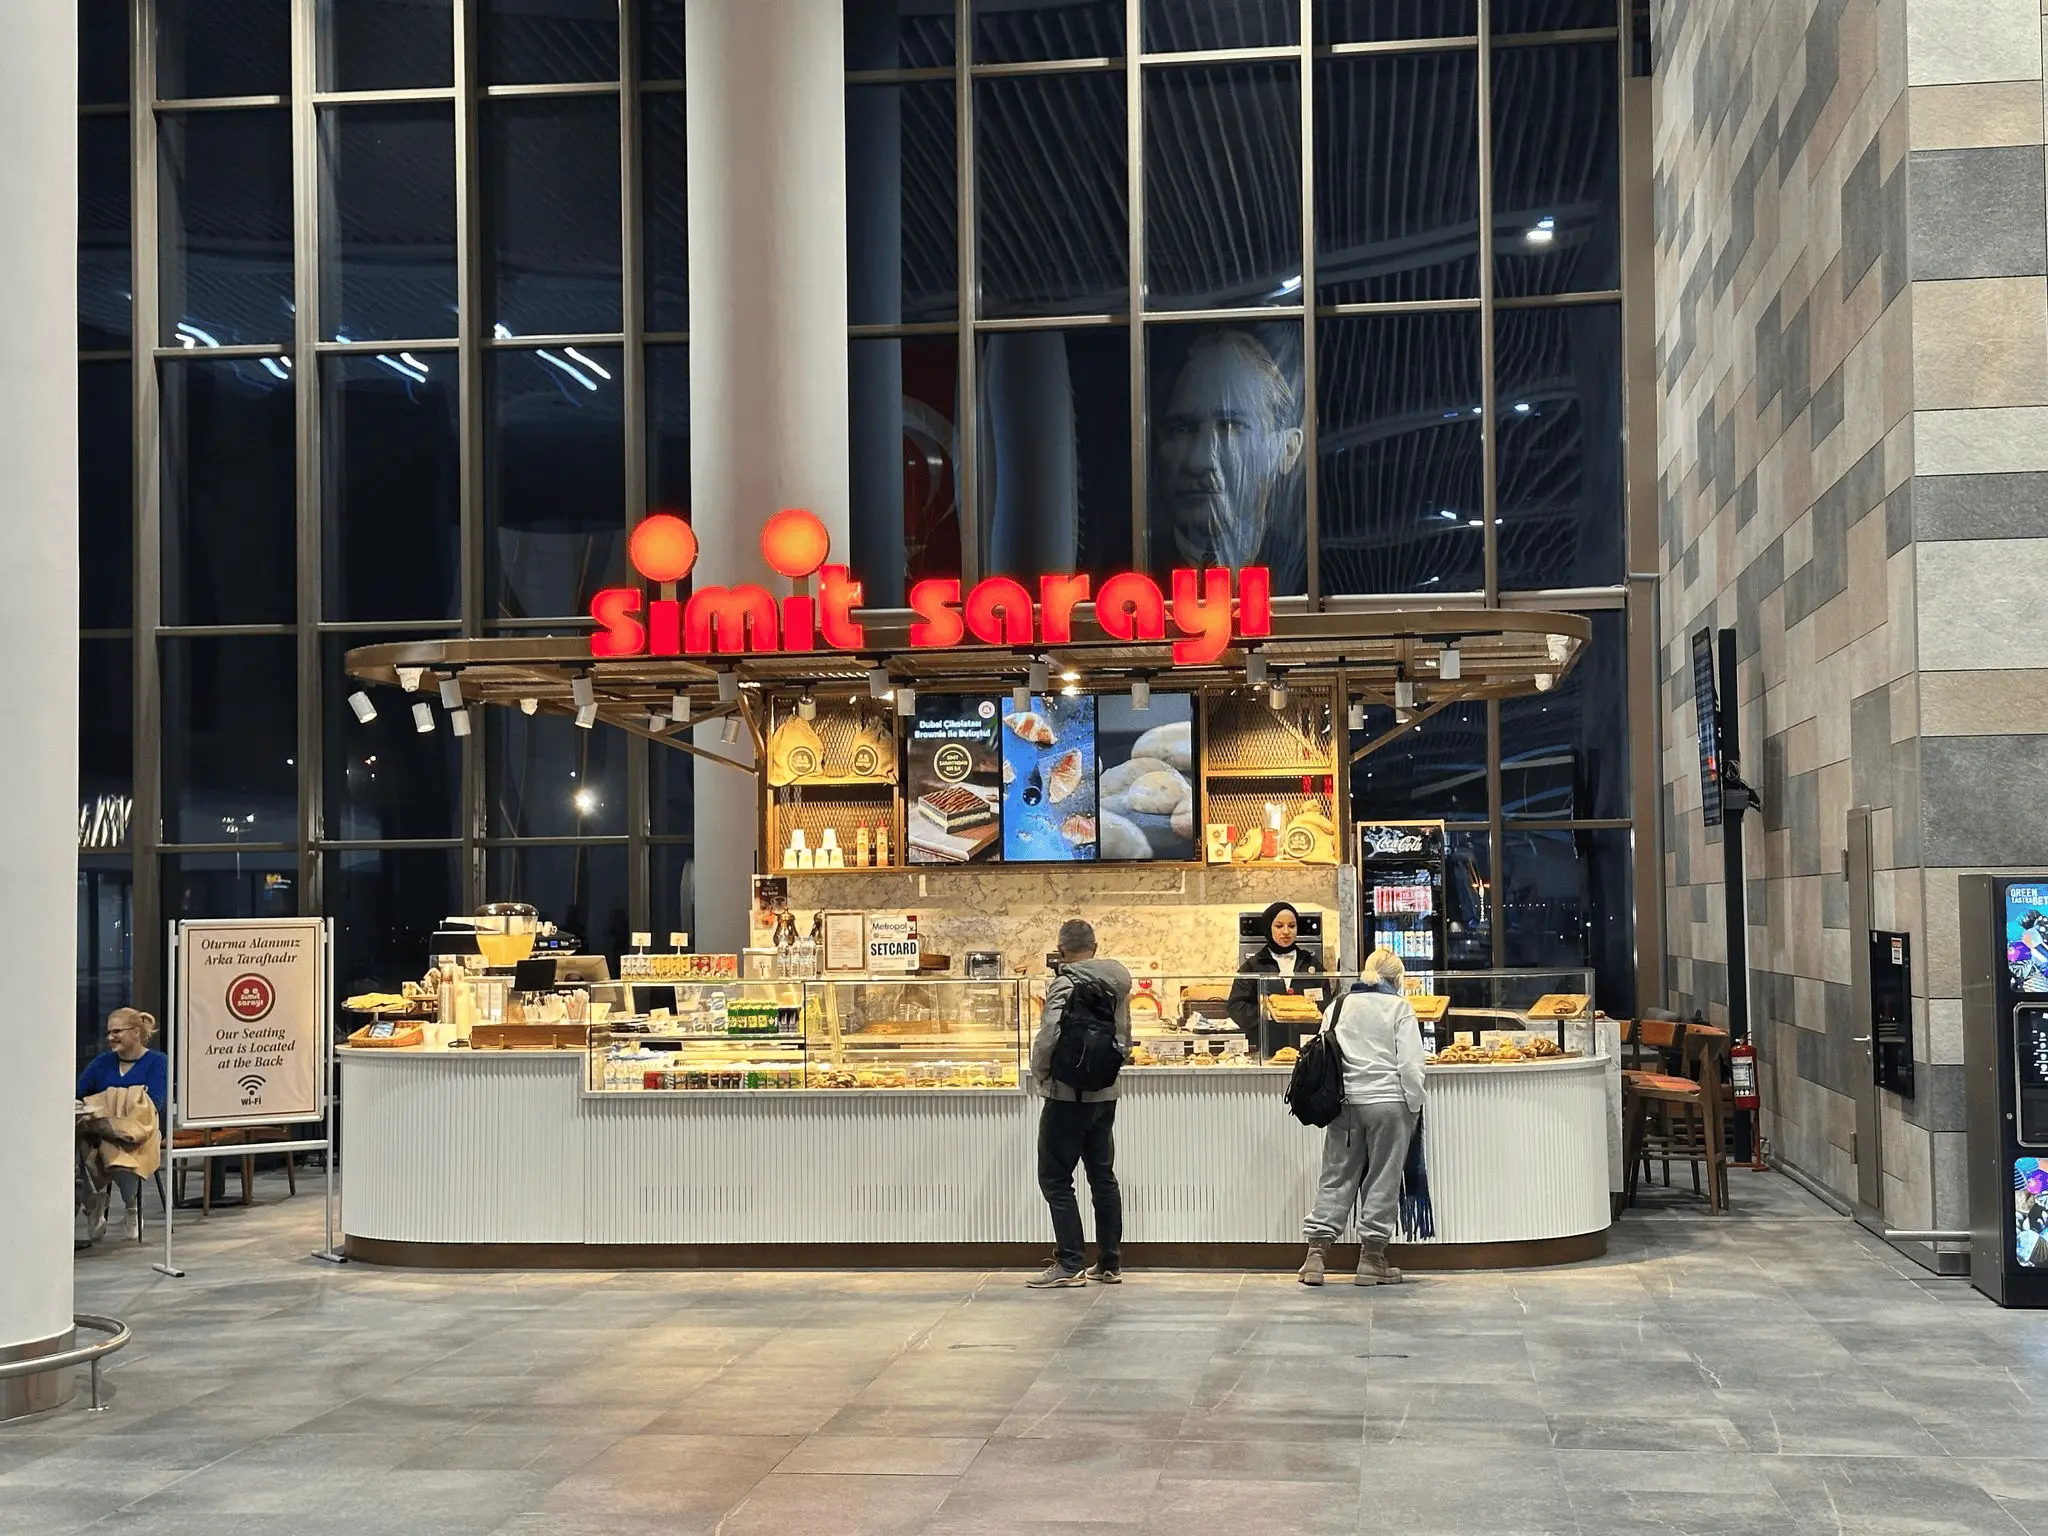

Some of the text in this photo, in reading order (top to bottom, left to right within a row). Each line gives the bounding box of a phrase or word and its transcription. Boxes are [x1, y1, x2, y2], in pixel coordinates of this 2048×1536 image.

[590, 509, 1271, 666] simit sarayı
[2010, 888, 2038, 897] GREEN
[872, 922, 907, 931] Metropol
[201, 937, 301, 950] Oturma Alanımız
[870, 942, 917, 956] SETCARD
[204, 952, 297, 966] Arka Taraftadır
[216, 1027, 285, 1041] Our Seating
[205, 1040, 295, 1056] Area is Located
[217, 1055, 284, 1070] at the Back
